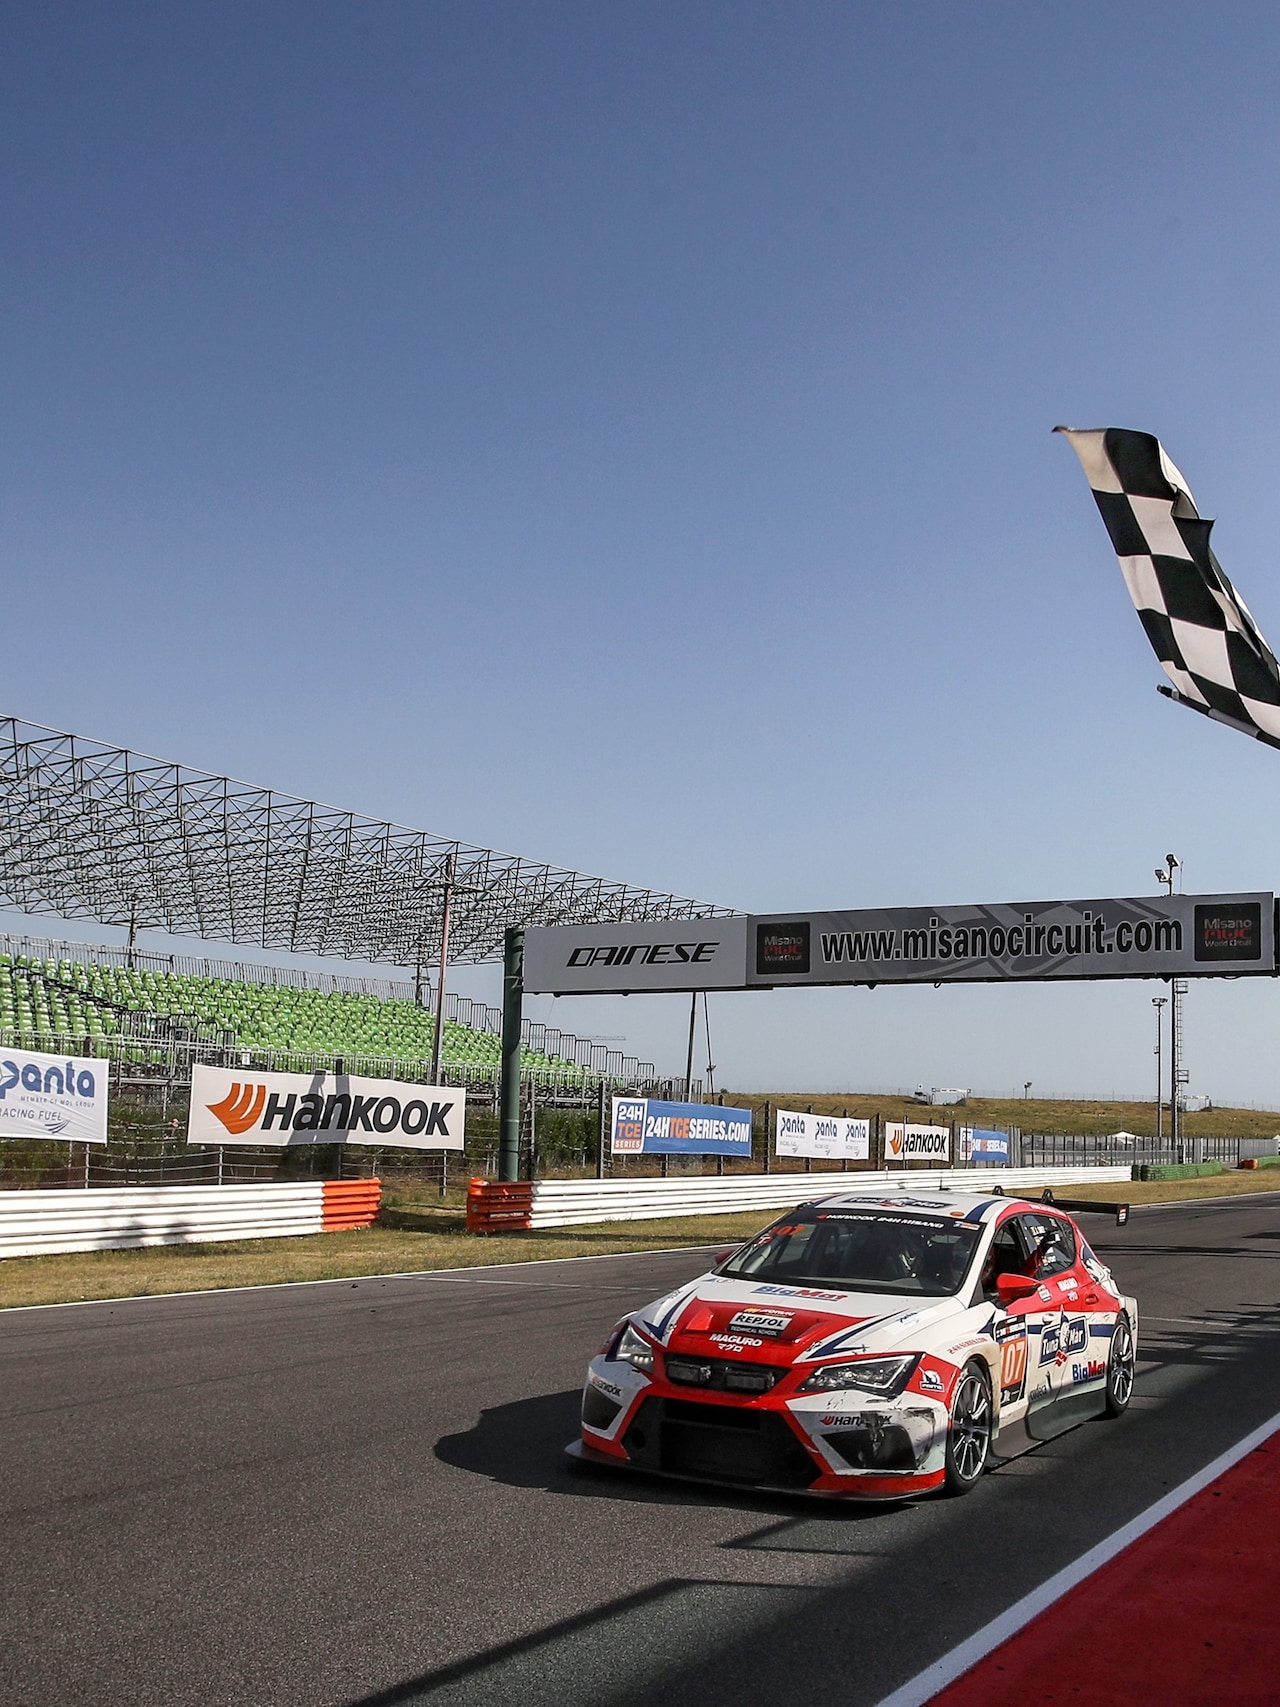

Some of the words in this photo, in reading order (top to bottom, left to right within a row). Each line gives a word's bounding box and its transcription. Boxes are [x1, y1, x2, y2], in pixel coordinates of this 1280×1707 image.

[1204, 918, 1252, 929] Misano
[764, 935, 803, 946] Misano
[819, 913, 1183, 963] www.misanocircuit.com
[566, 942, 720, 967] DAINESE
[0, 1108, 36, 1120] ACING
[38, 1110, 63, 1121] FUEL
[618, 1105, 643, 1121] 24H
[618, 1122, 641, 1138] TCE
[645, 1116, 750, 1143] 24HTCESERIES.COM
[615, 1140, 641, 1149] SERIES
[735, 1314, 785, 1327] REPSOL
[709, 1333, 763, 1347] MAGURO
[1000, 1341, 1025, 1384] 107
